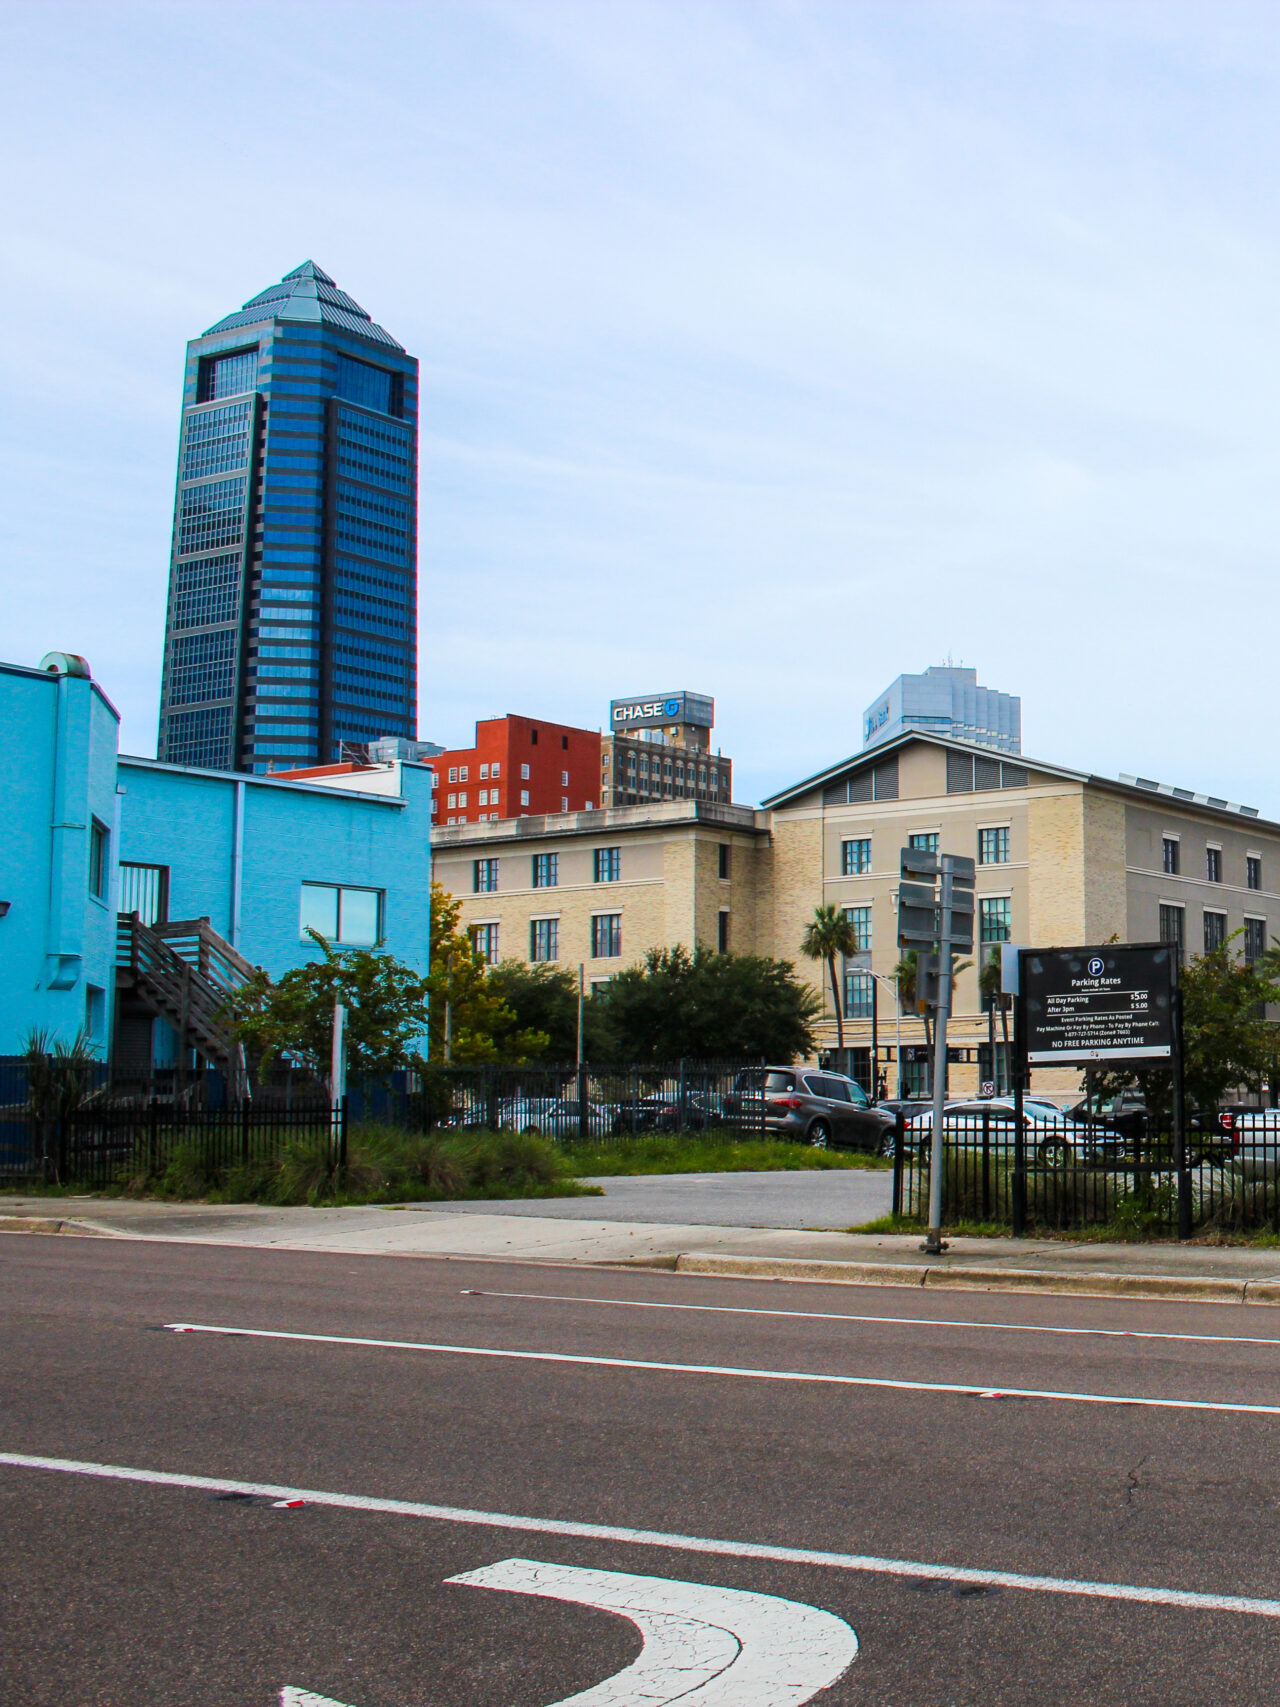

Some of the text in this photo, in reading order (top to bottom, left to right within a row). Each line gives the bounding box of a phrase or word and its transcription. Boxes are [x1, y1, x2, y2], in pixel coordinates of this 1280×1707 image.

[613, 702, 663, 720] CHASE
[1092, 961, 1100, 973] P
[1071, 977, 1121, 987] Parking Rates
[1067, 996, 1089, 1004] Parking
[1052, 1036, 1144, 1048] NO FREE PARKING ANYTIME
